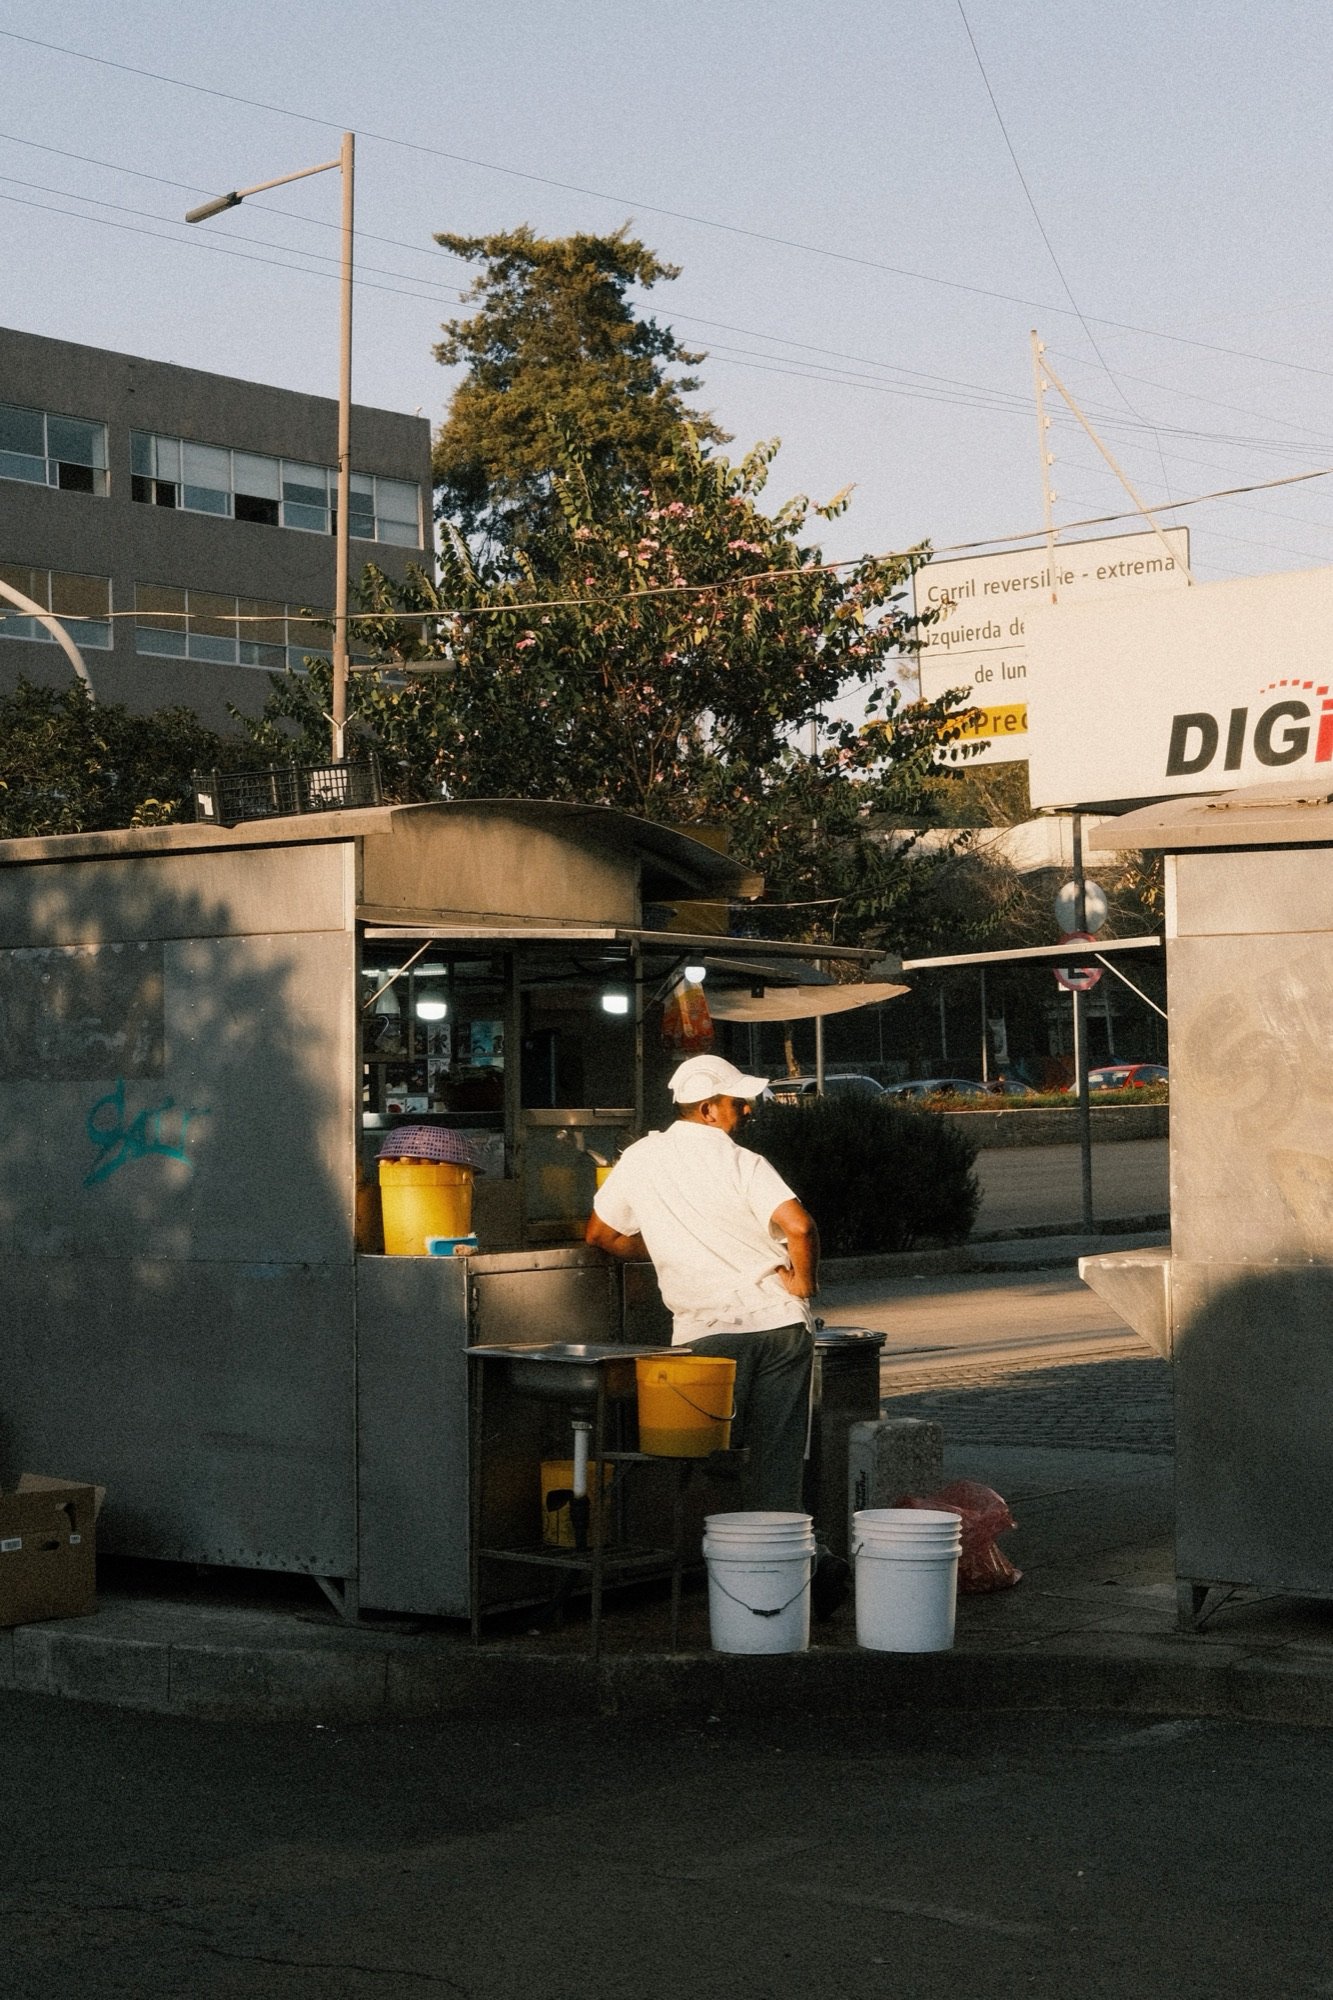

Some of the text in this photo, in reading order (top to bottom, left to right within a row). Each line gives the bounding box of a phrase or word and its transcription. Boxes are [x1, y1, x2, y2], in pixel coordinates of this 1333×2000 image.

[928, 578, 975, 602] Carril
[1096, 557, 1175, 580] extrema
[926, 620, 1002, 650] izquierda
[974, 664, 994, 684] de
